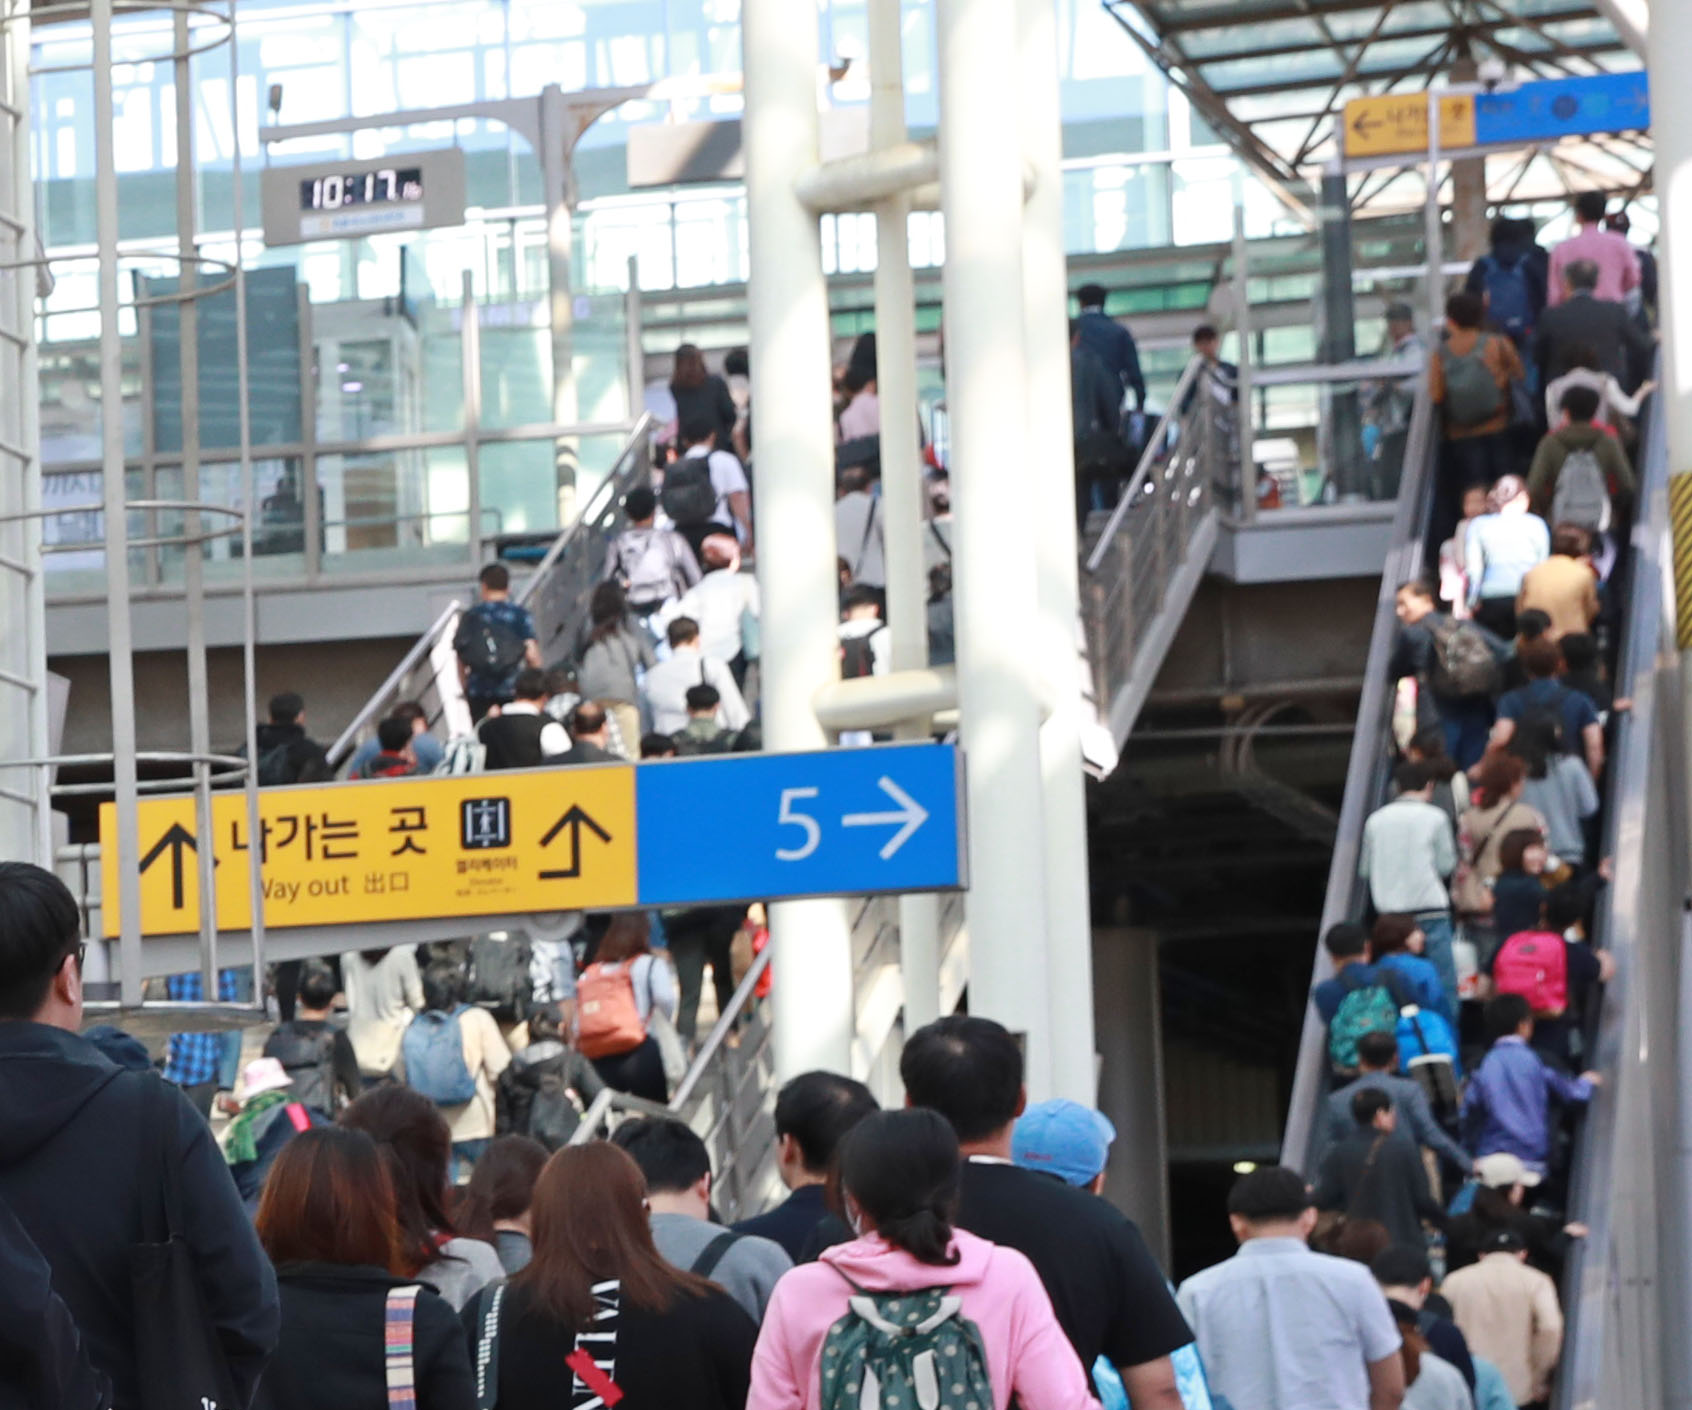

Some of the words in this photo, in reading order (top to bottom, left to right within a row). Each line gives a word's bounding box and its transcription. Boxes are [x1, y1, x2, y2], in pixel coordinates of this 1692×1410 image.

[312, 169, 398, 209] 10:17
[231, 812, 359, 865] 나가는
[388, 806, 429, 857] 곳
[775, 786, 821, 863] 5
[308, 876, 350, 897] out
[363, 868, 410, 895] 出口
